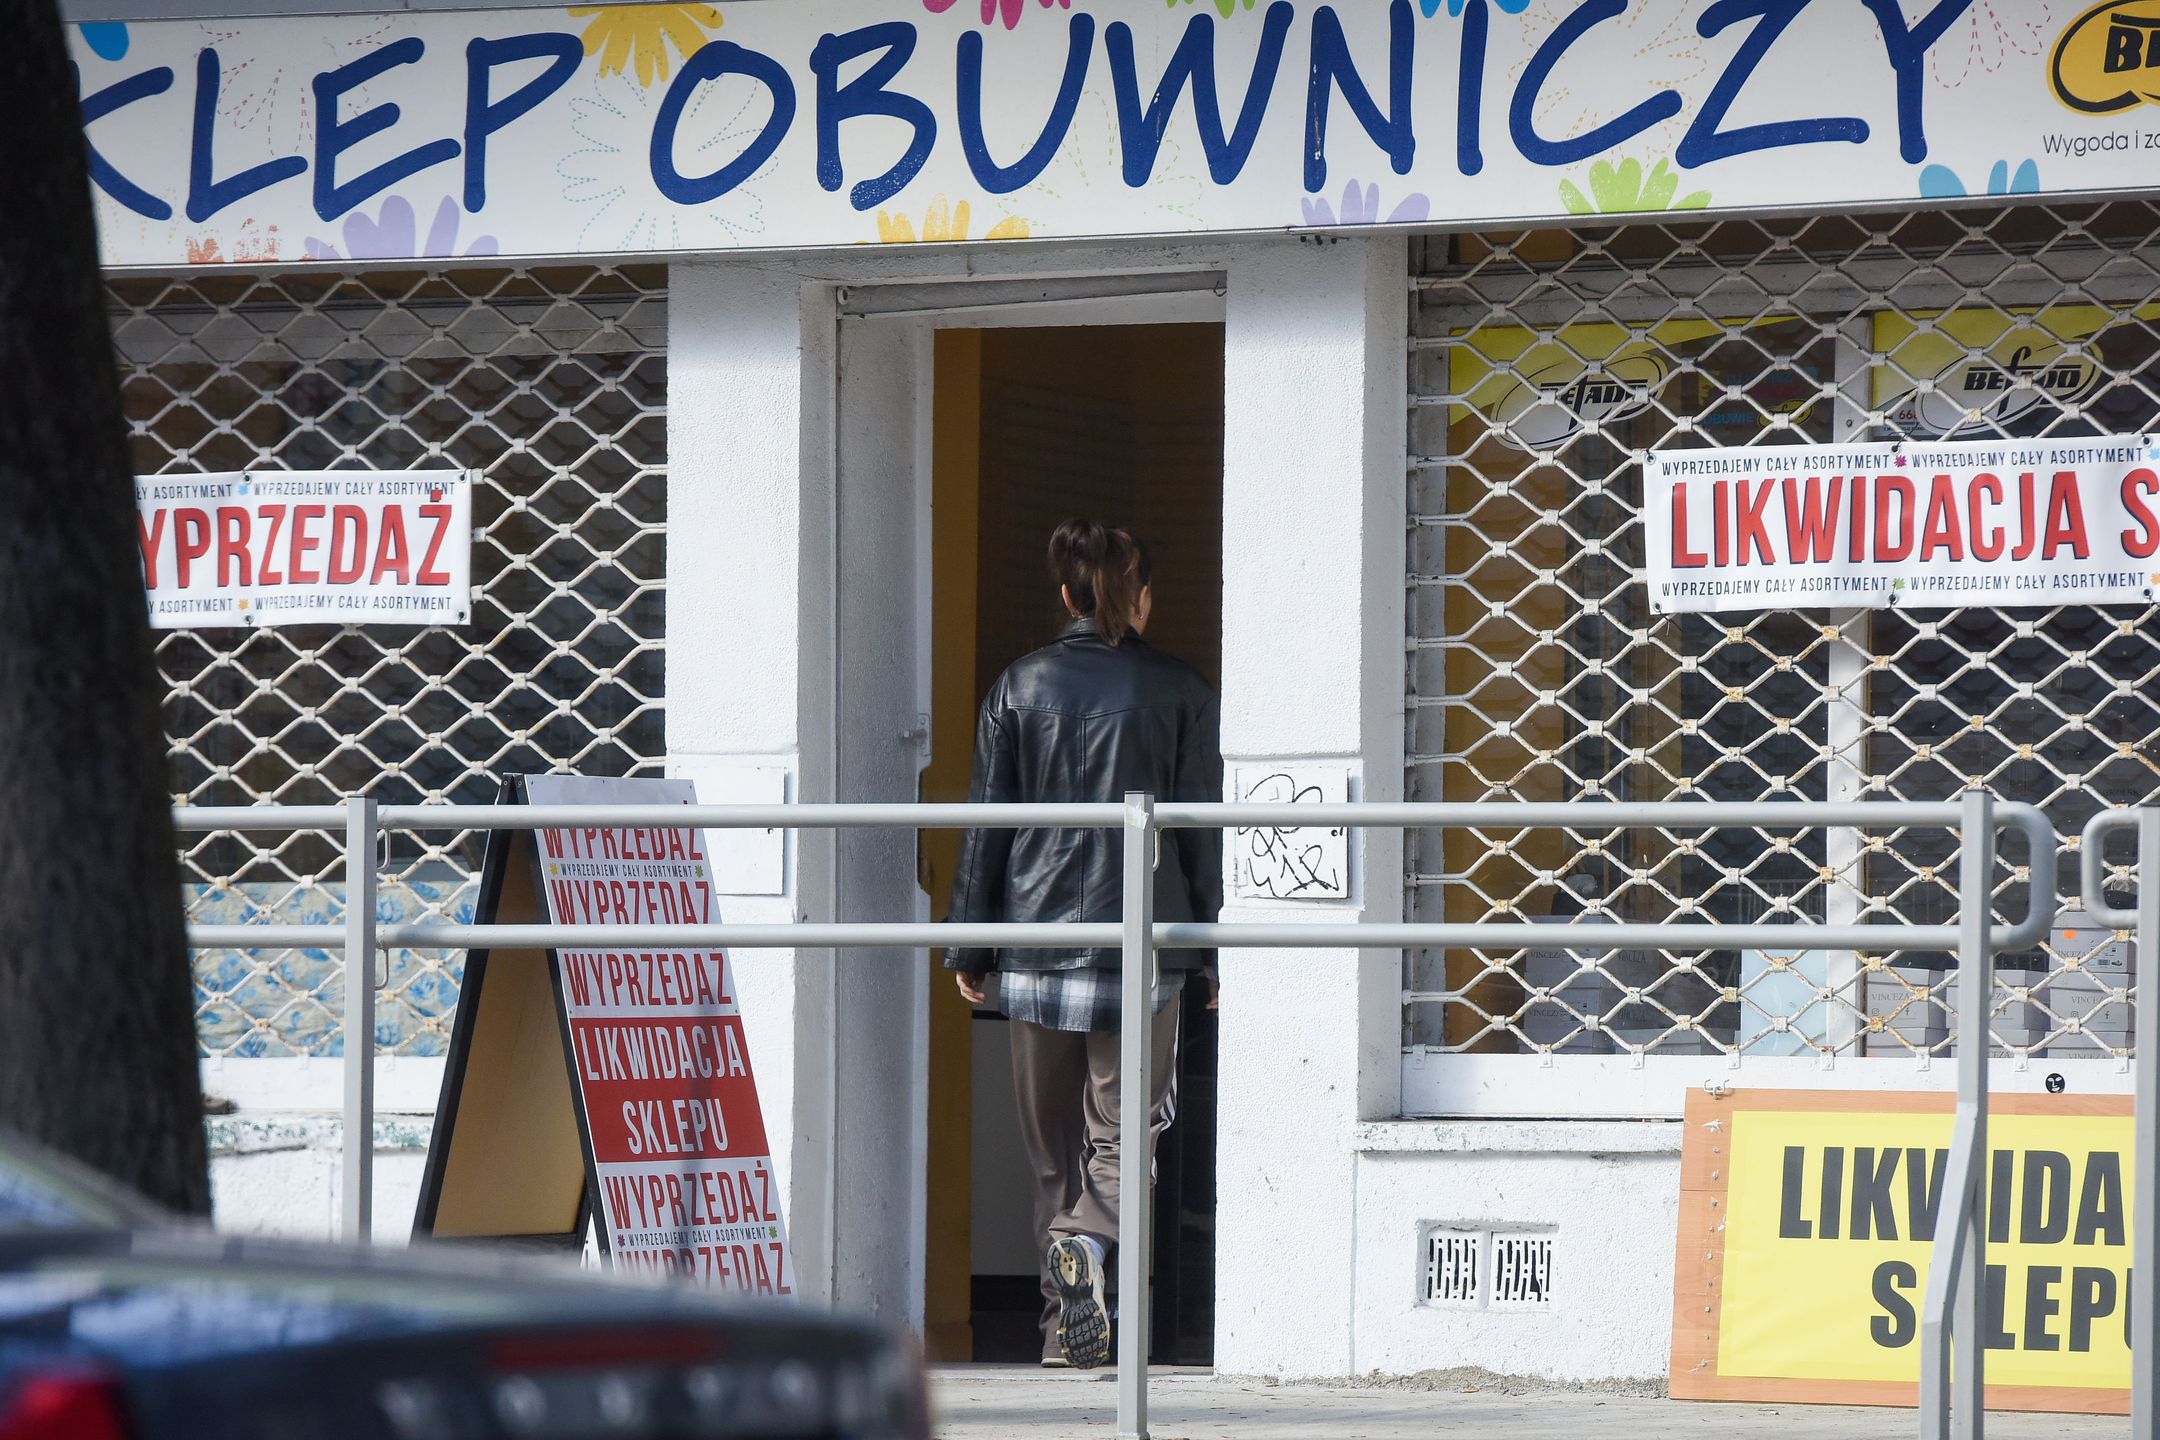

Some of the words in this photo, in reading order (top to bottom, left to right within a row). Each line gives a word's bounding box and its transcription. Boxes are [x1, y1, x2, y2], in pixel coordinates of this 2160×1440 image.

[650, 0, 1974, 211] OBUWNICZY
[2042, 131, 2128, 158] Wygoda
[2135, 130, 2139, 149] i
[1662, 458, 1761, 476] WYPRZEDAJEMY
[1766, 456, 1798, 472] CAŁY
[1803, 454, 1890, 470] ASORTYMENT
[1912, 452, 2005, 468] WYPRZEDAJEMY
[2011, 450, 2044, 466] CAŁY
[2050, 447, 2143, 465] ASORTYMENT
[154, 484, 232, 499] ASORTYMENT
[254, 482, 340, 496] WYPRZEDAJEMY
[345, 482, 373, 496] CAŁY
[379, 482, 455, 496] ASORTYMENT
[1671, 471, 2091, 568] LIKWIDACJA
[2120, 468, 2160, 560] S
[1662, 579, 1760, 597] WYPRZEDAJEMY
[1766, 577, 1797, 593] CAŁY
[1800, 576, 1888, 592] ASORTYMENT
[1910, 575, 2010, 591] WYPRZEDAJEMY
[2015, 574, 2048, 590] CAŁY
[2053, 572, 2145, 589] ASORTYMENT
[159, 599, 233, 613] ASORTYMENT
[255, 595, 333, 610] WYPRZEDAJEMY
[338, 595, 371, 609] CAŁY
[373, 596, 452, 610] ASORTYMENT
[561, 863, 619, 877] WYPRZEDAJEMY
[622, 864, 640, 877] CAŁY
[644, 865, 693, 878] ASORTYMENT
[579, 1024, 747, 1081] LIKWIDACJA
[622, 1098, 729, 1155] SKLEPU
[605, 1160, 777, 1230] WYPRZEDAŻ
[628, 1231, 689, 1247] WYPRZEDAJEMY
[692, 1230, 712, 1243] CAŁY
[716, 1227, 766, 1242] ASORTYMENT
[1870, 1260, 2133, 1353] SLEP
